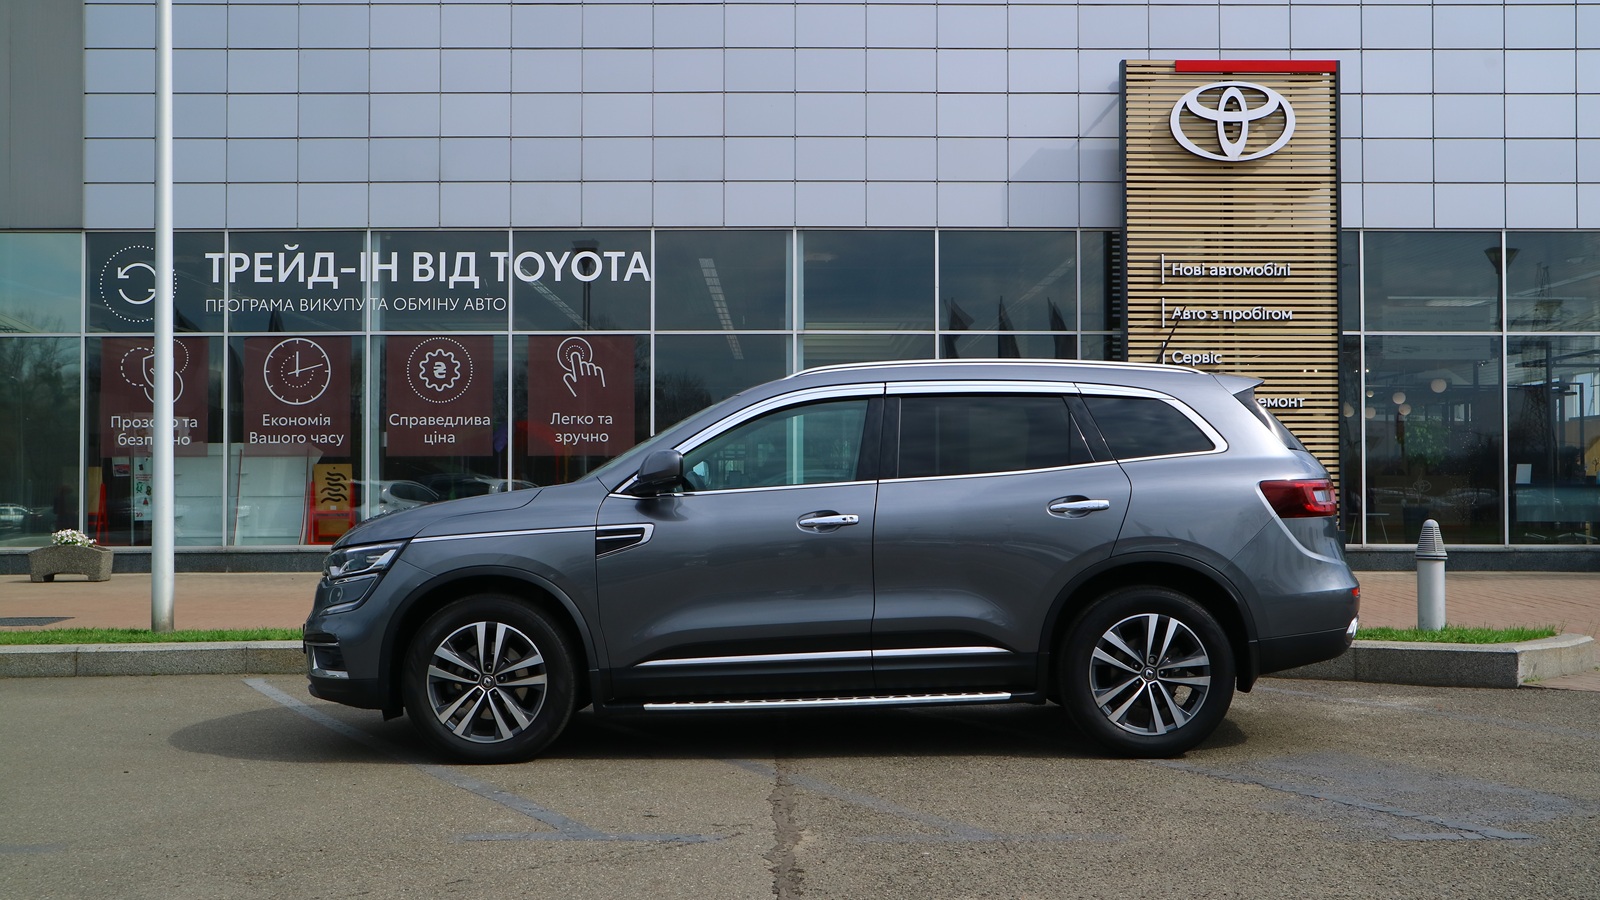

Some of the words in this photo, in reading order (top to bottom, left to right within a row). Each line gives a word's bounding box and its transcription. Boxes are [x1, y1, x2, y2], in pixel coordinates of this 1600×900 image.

[205, 244, 398, 289] ТРЕЙД-ІН
[412, 251, 480, 289] ВІД
[490, 251, 651, 282] TOYOTA
[1171, 262, 1206, 277] Нові
[1209, 262, 1291, 277] автомобілі
[205, 298, 294, 312] ПРОГРАМА
[299, 297, 366, 312] ВИКУПУ
[368, 297, 389, 311] ТА
[393, 297, 460, 311] ОБМІНУ
[464, 297, 507, 311] АВТО
[1171, 307, 1207, 320] Авто
[1210, 309, 1219, 320] з
[1223, 306, 1293, 323] пробігом
[1171, 351, 1223, 367] Сервіс
[1257, 397, 1305, 408] емонт
[110, 415, 179, 431] Прозо
[182, 418, 198, 428] та
[262, 413, 331, 426] Економія
[389, 413, 491, 429] Справедлива
[550, 412, 594, 425] Легко
[598, 415, 613, 425] та
[117, 432, 191, 446] безпно
[249, 432, 308, 445] Вашого
[311, 433, 345, 446] часу
[424, 431, 456, 445] ціна
[554, 432, 609, 446] зручно
